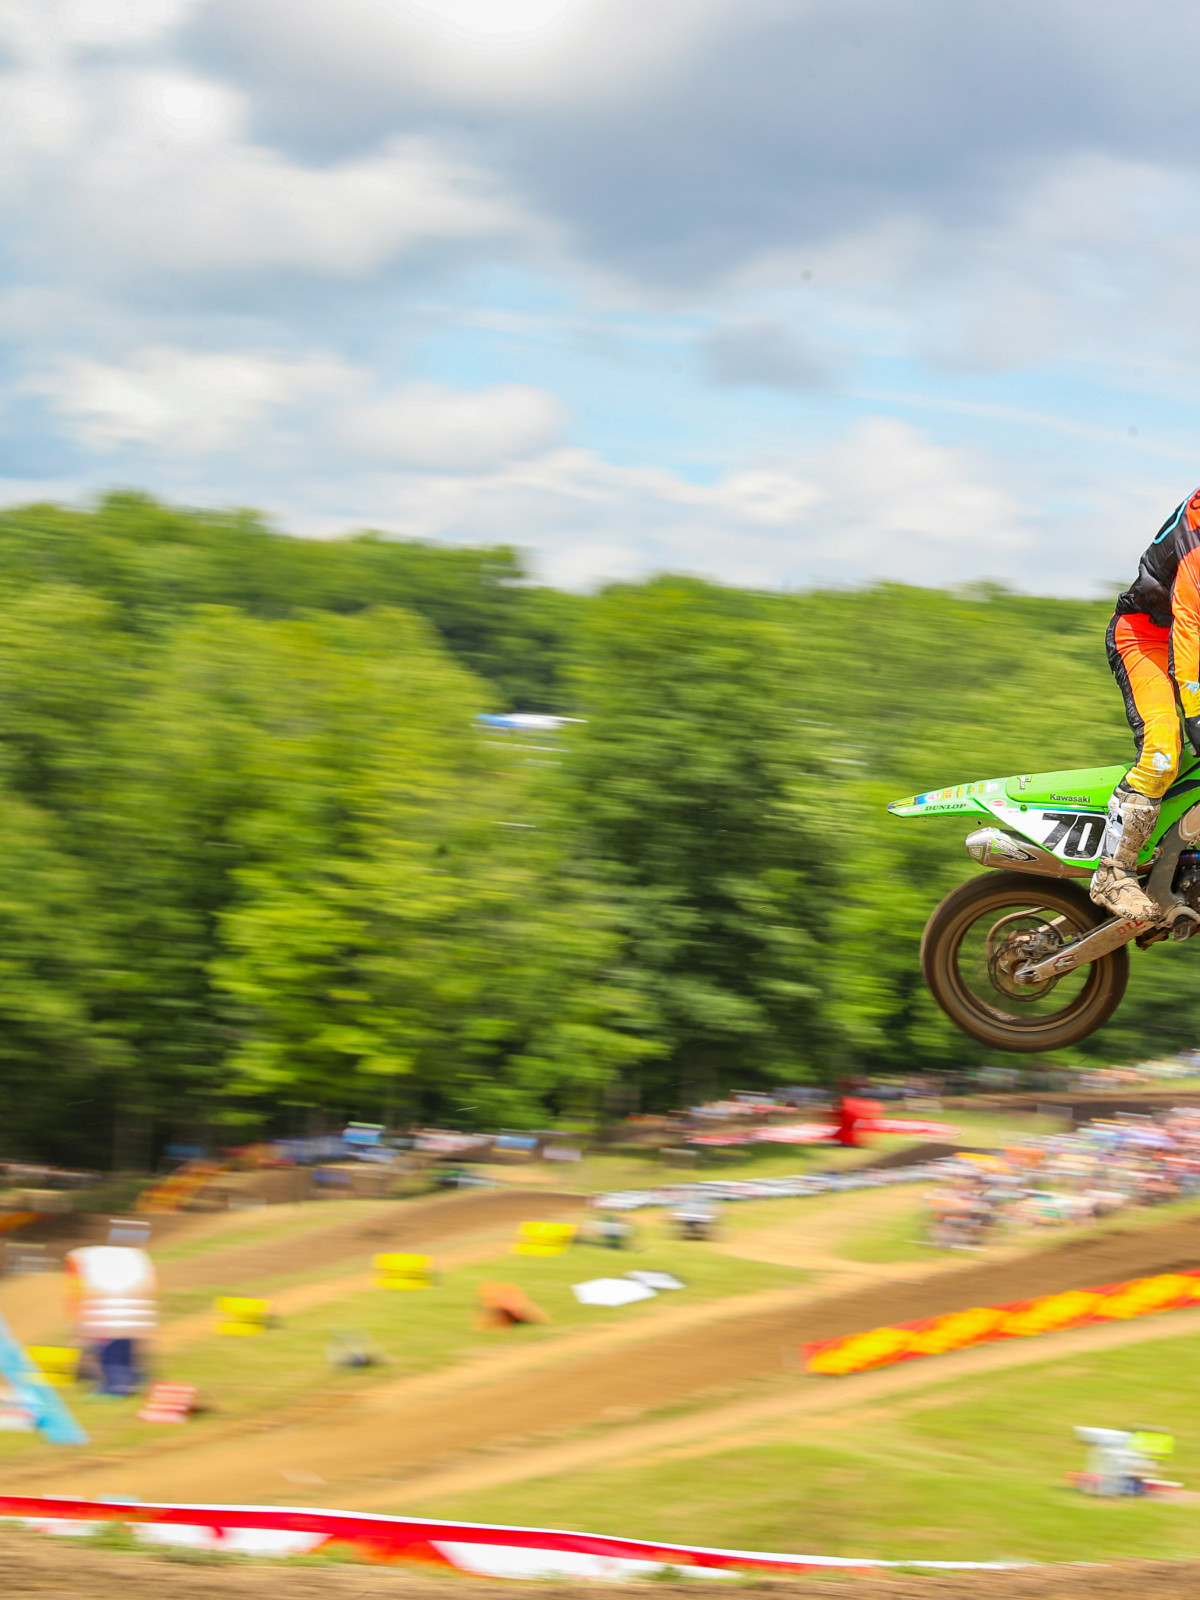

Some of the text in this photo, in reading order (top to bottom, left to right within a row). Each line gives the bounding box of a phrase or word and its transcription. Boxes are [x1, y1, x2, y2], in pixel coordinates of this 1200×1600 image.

[1049, 793, 1091, 804] Kawasaki
[925, 803, 967, 811] DUNLOP
[1042, 812, 1107, 859] 70
[1122, 908, 1138, 921] FOX
